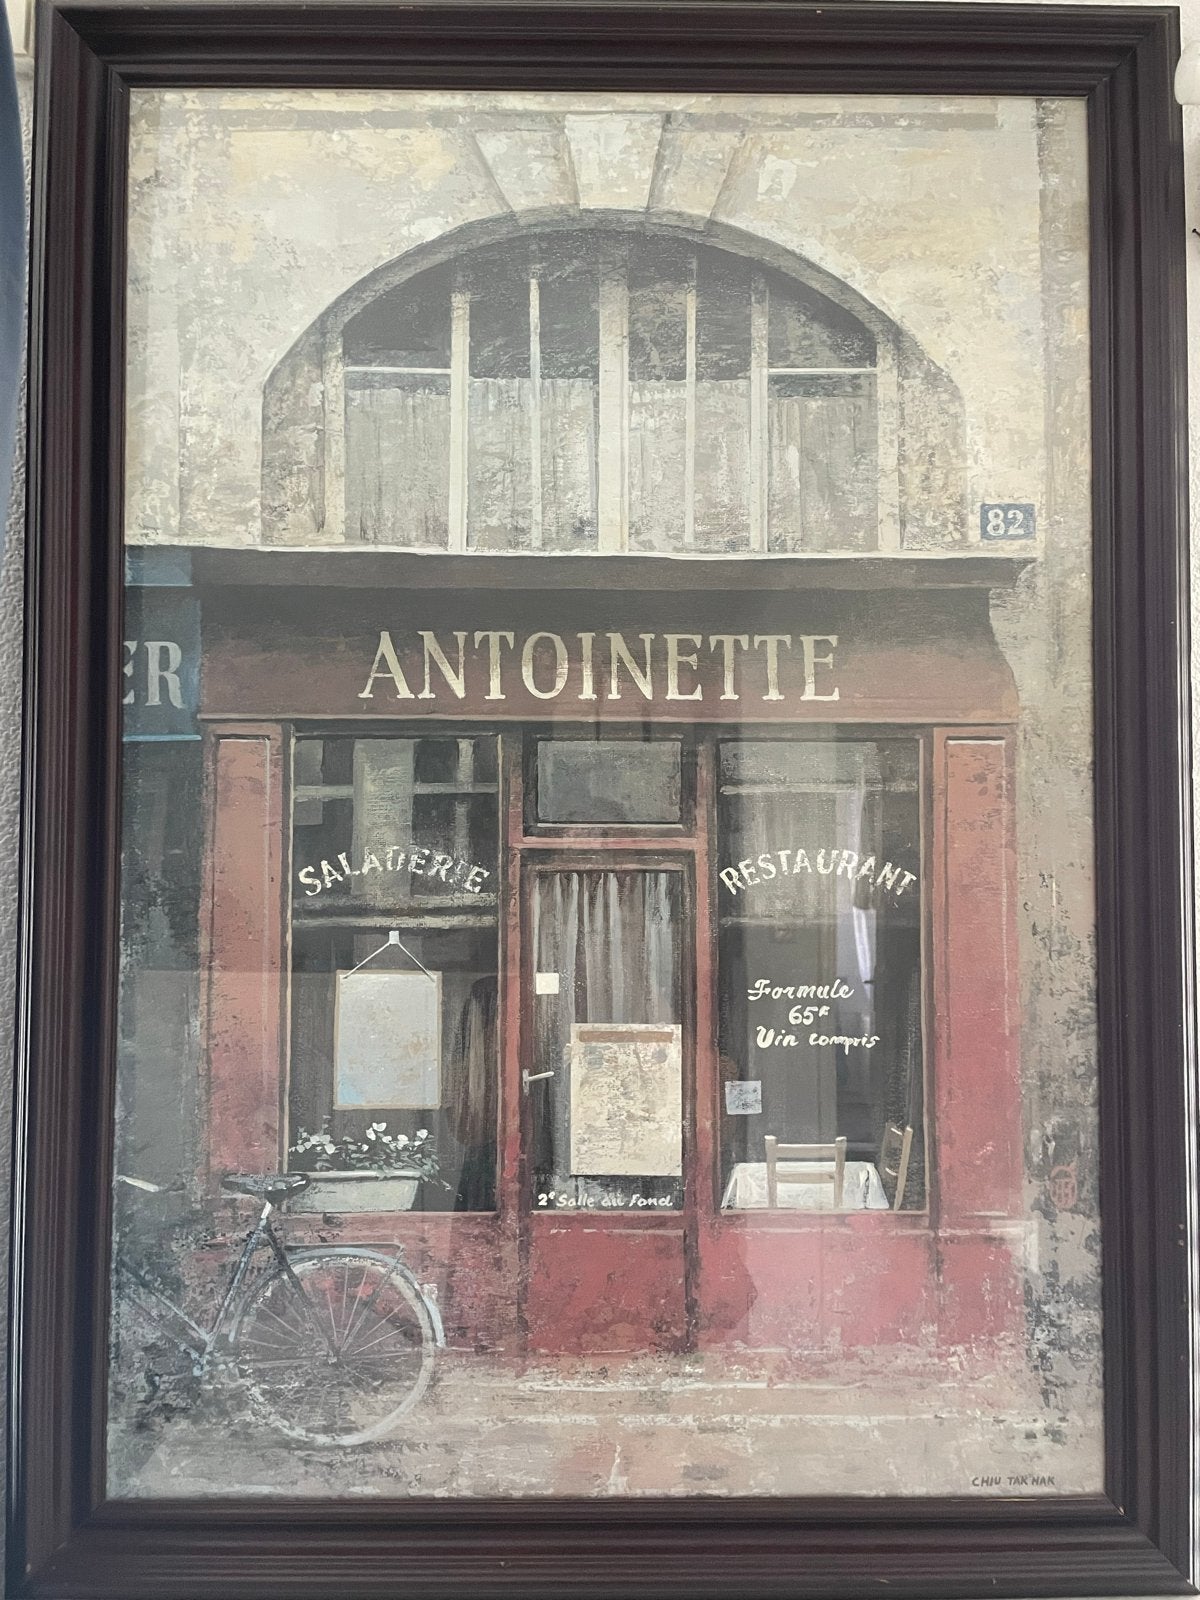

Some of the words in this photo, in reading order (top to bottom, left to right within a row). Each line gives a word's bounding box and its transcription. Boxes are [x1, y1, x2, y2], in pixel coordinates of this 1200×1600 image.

[986, 509, 1025, 536] 82
[358, 631, 839, 701] ANTOINETTE
[719, 848, 918, 896] RESTAURANT
[747, 978, 855, 1001] Formule
[756, 1025, 799, 1048] Vin
[808, 1033, 881, 1055] compris
[556, 1193, 594, 1207] Salle
[971, 1476, 1002, 1487] CHIU
[1007, 1475, 1029, 1486] TAK
